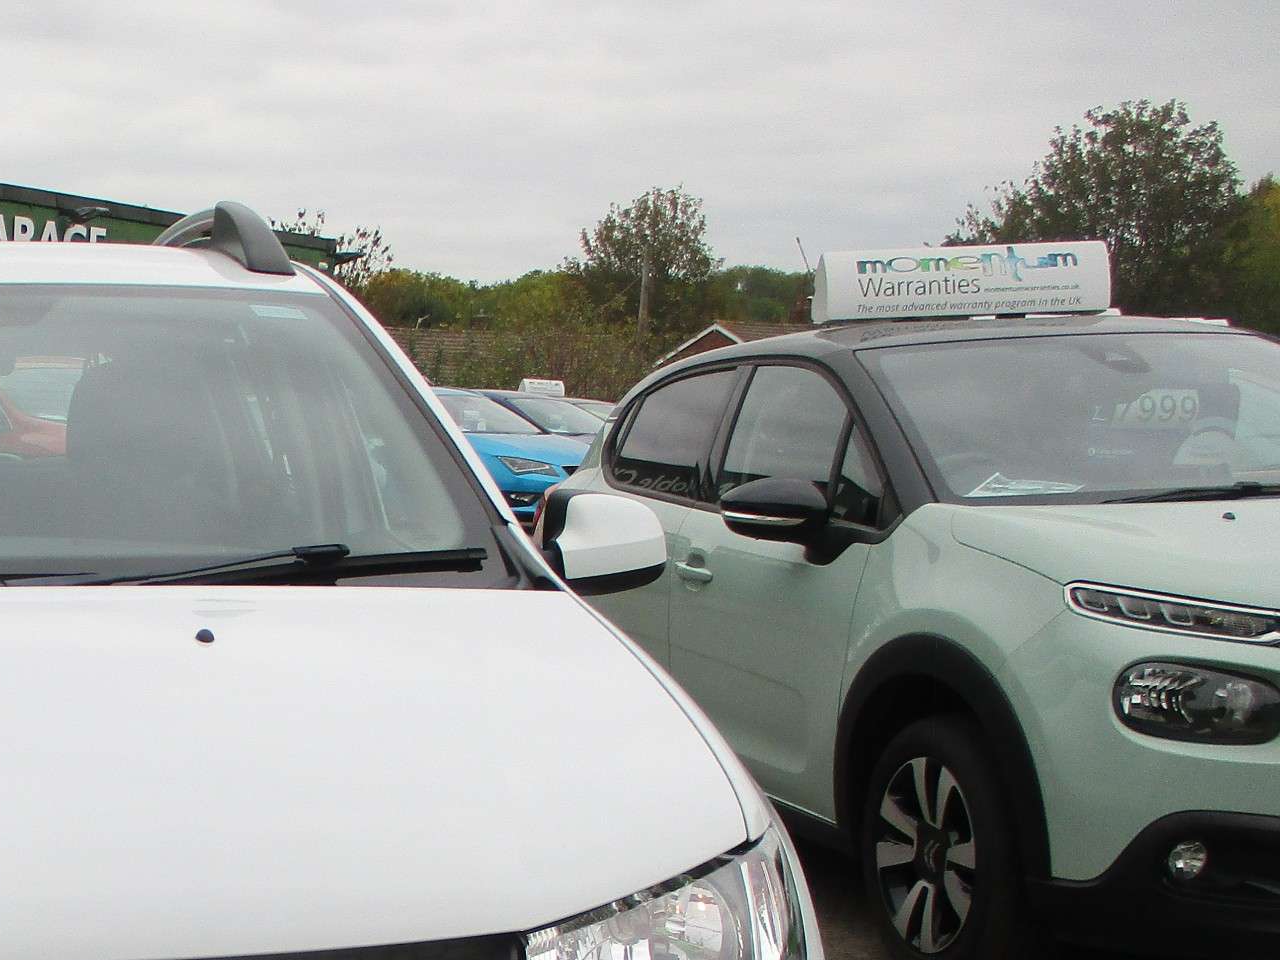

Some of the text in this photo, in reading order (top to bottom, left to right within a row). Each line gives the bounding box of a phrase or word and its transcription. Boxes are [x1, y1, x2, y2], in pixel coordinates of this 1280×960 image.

[856, 246, 1078, 281] momentum
[857, 273, 981, 298] Warranties
[856, 296, 1081, 313] The most advanced warranty program in the UK
